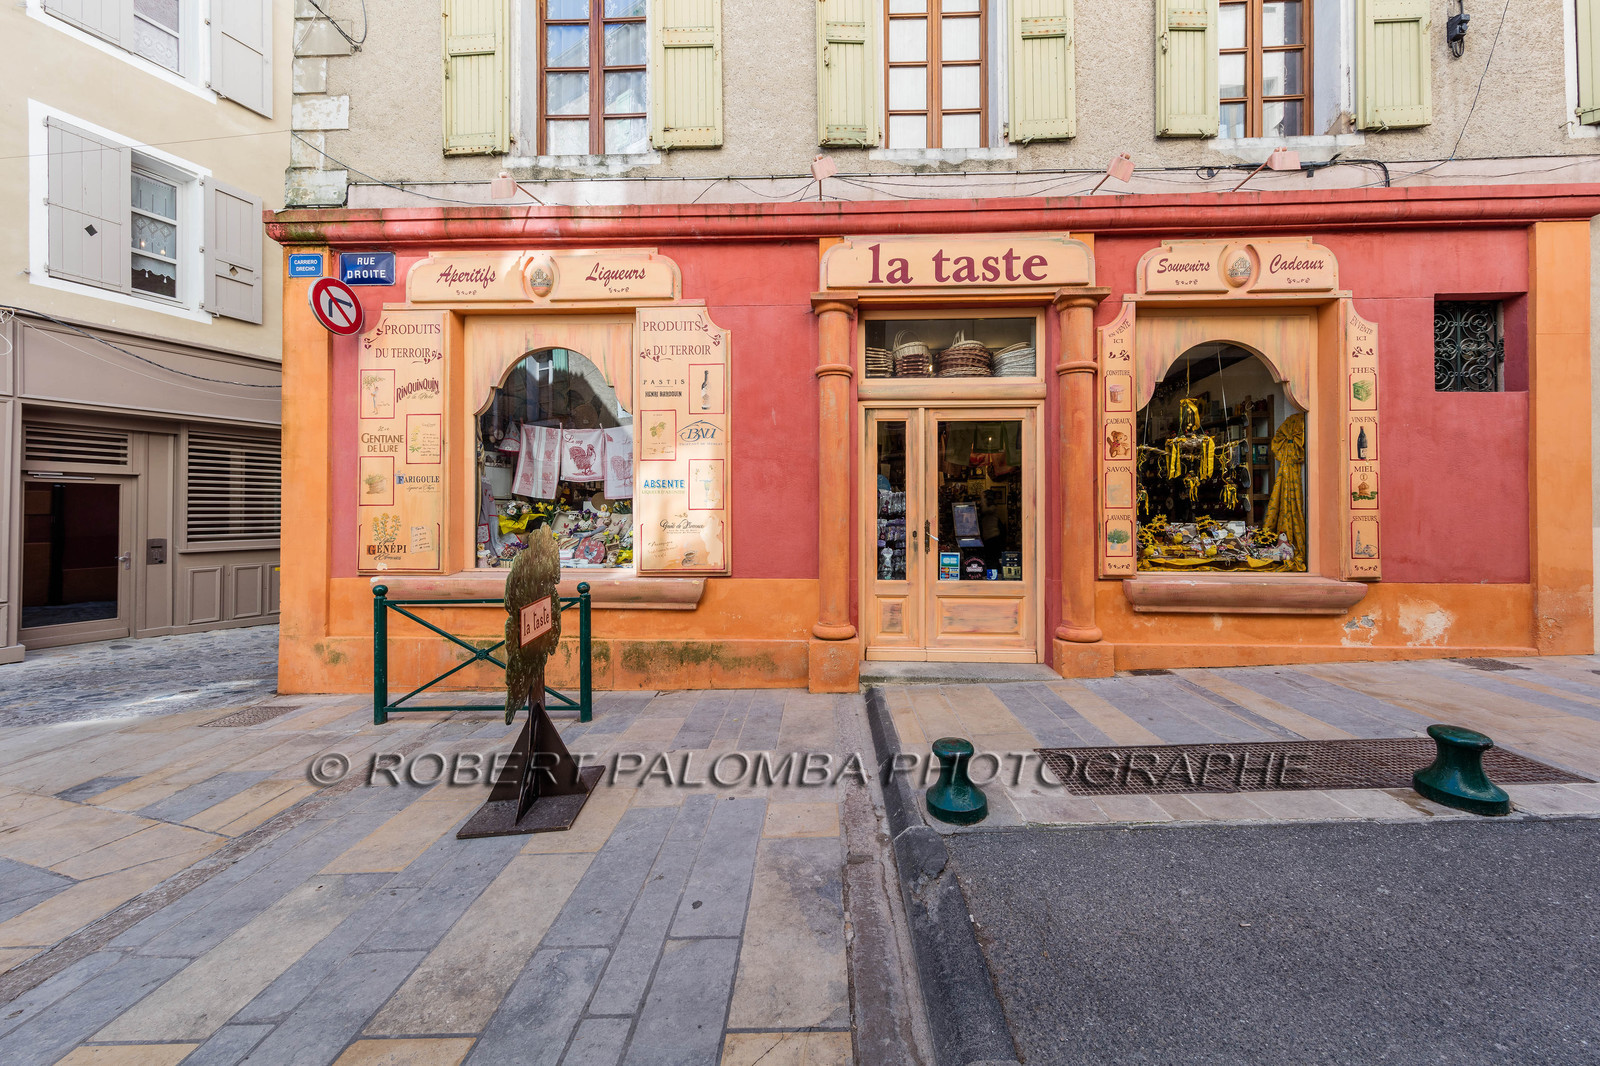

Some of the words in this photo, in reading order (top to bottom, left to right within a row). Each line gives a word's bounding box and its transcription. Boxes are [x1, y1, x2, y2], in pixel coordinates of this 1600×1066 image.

[357, 257, 375, 265] RUE
[868, 243, 913, 284] la
[932, 247, 1048, 283] taste
[1157, 258, 1210, 274] Souvenirs
[1269, 253, 1324, 274] Cadeaux
[347, 270, 386, 279] DROITE
[437, 264, 496, 289] Aperitifs
[585, 262, 646, 286] Liqueurs
[385, 324, 440, 335] PRODUITS
[642, 321, 701, 332] PRODUITS
[1116, 319, 1132, 335] VENTE
[1350, 315, 1358, 326] EN
[1358, 322, 1374, 334] VENTE
[376, 348, 388, 358] DU
[391, 348, 431, 358] TERROIR
[653, 345, 667, 356] DU
[670, 345, 712, 356] TERROIR
[361, 432, 404, 444] GENTIANE
[368, 444, 376, 452] DE
[380, 443, 398, 452] LURE
[397, 476, 440, 484] FARIGOULE
[643, 480, 685, 488] ABSENTE
[524, 613, 530, 636] la
[533, 606, 550, 631] taste
